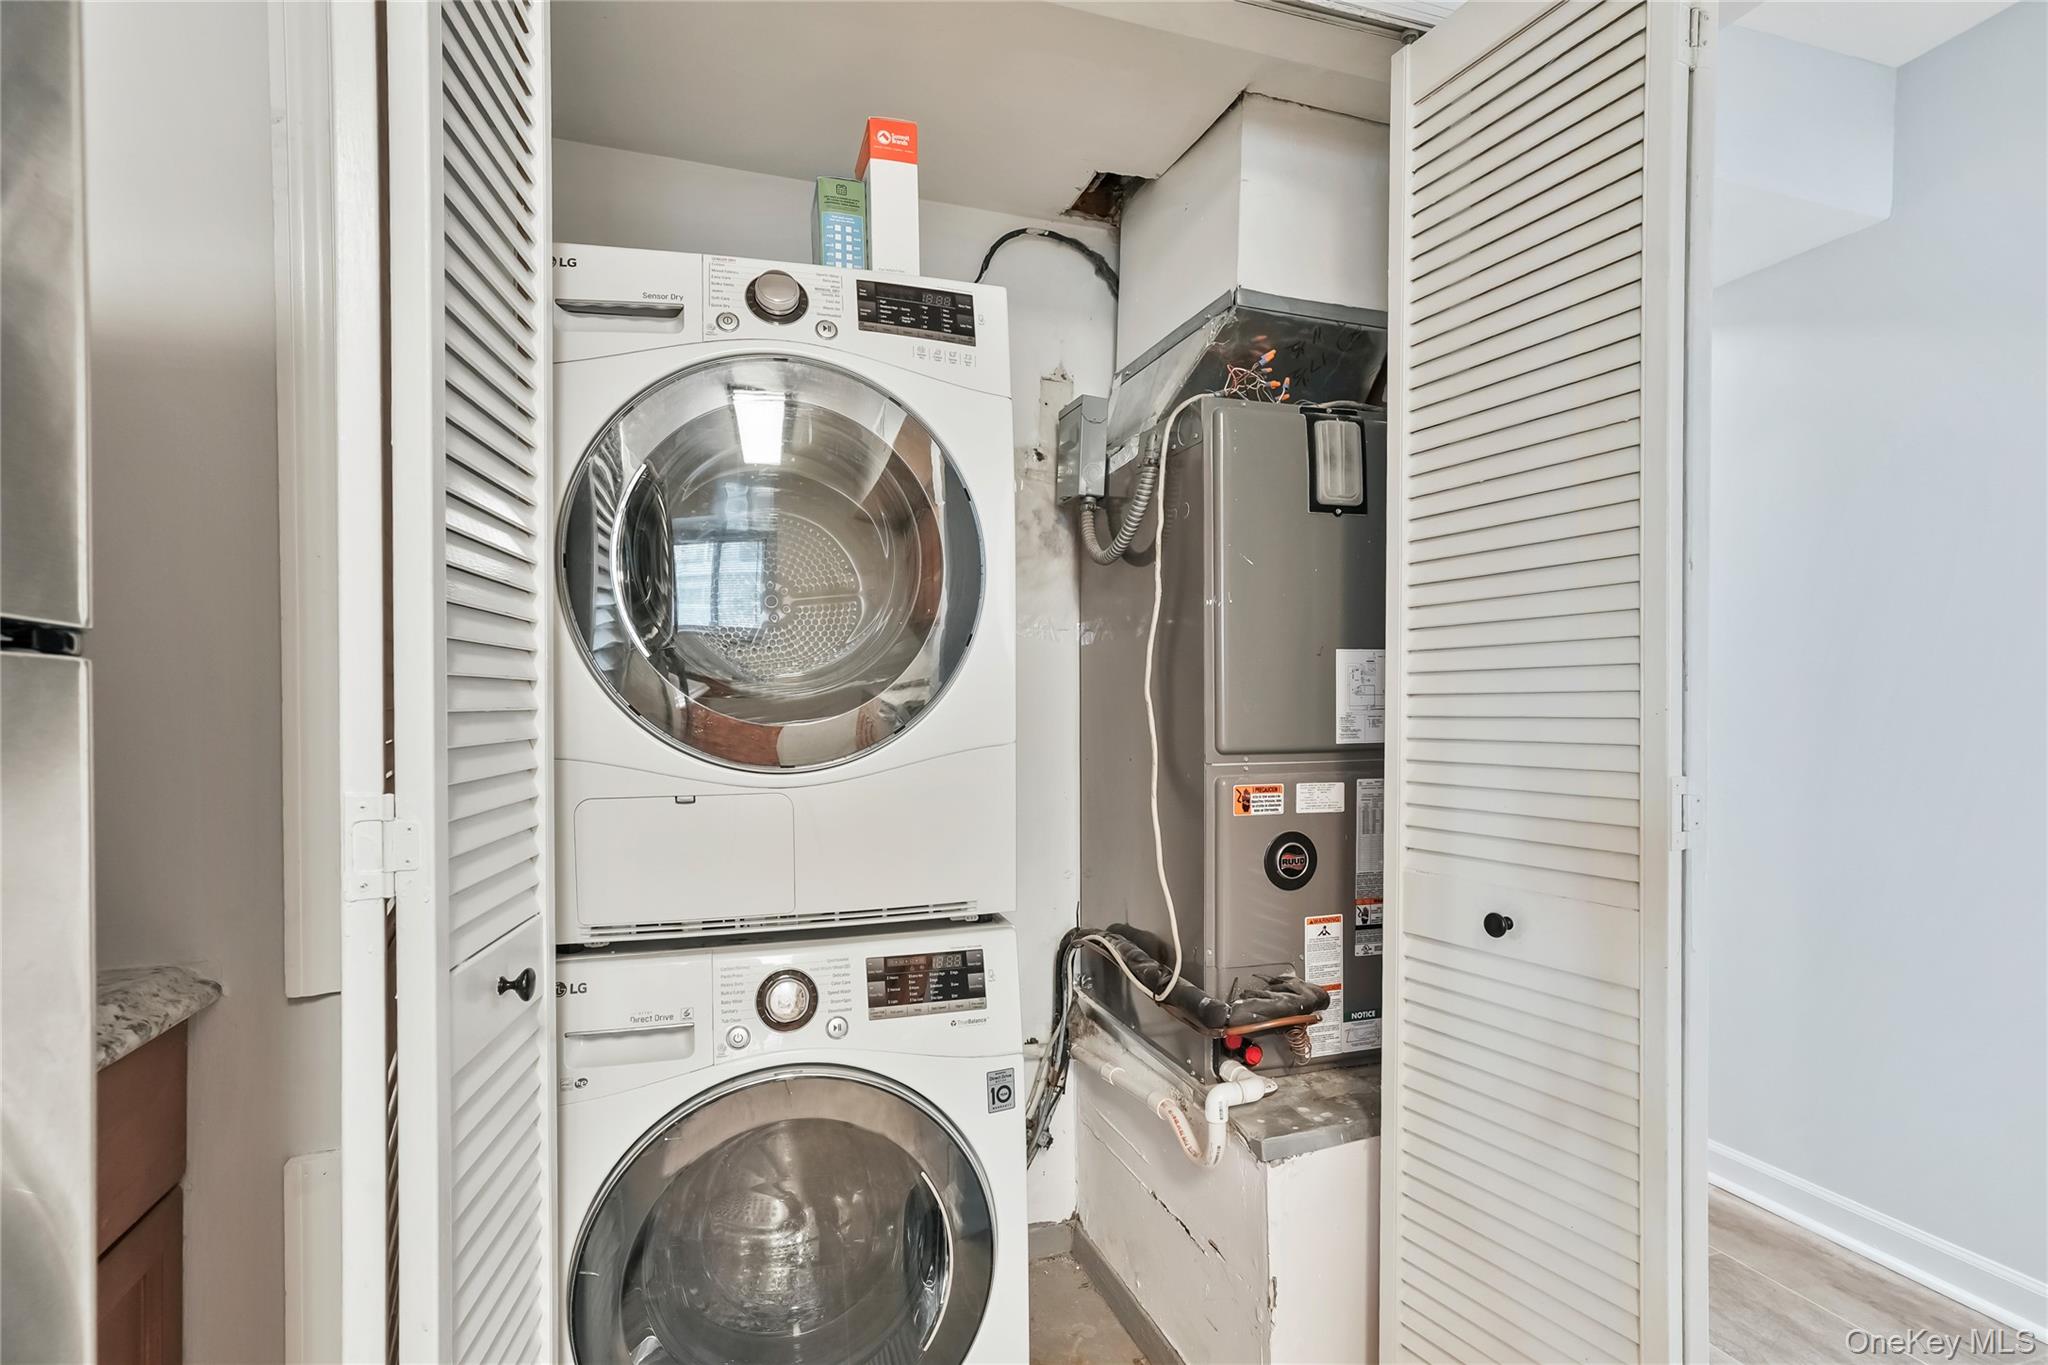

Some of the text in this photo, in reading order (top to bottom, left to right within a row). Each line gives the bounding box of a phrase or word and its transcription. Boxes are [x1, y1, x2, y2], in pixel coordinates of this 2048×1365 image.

[559, 257, 577, 268] LG
[642, 291, 684, 302] Sensor Dry
[1283, 857, 1305, 866] RUUD
[570, 982, 588, 995] LG
[630, 1013, 674, 1024] Direct Drive
[1351, 1010, 1376, 1019] NOTICE
